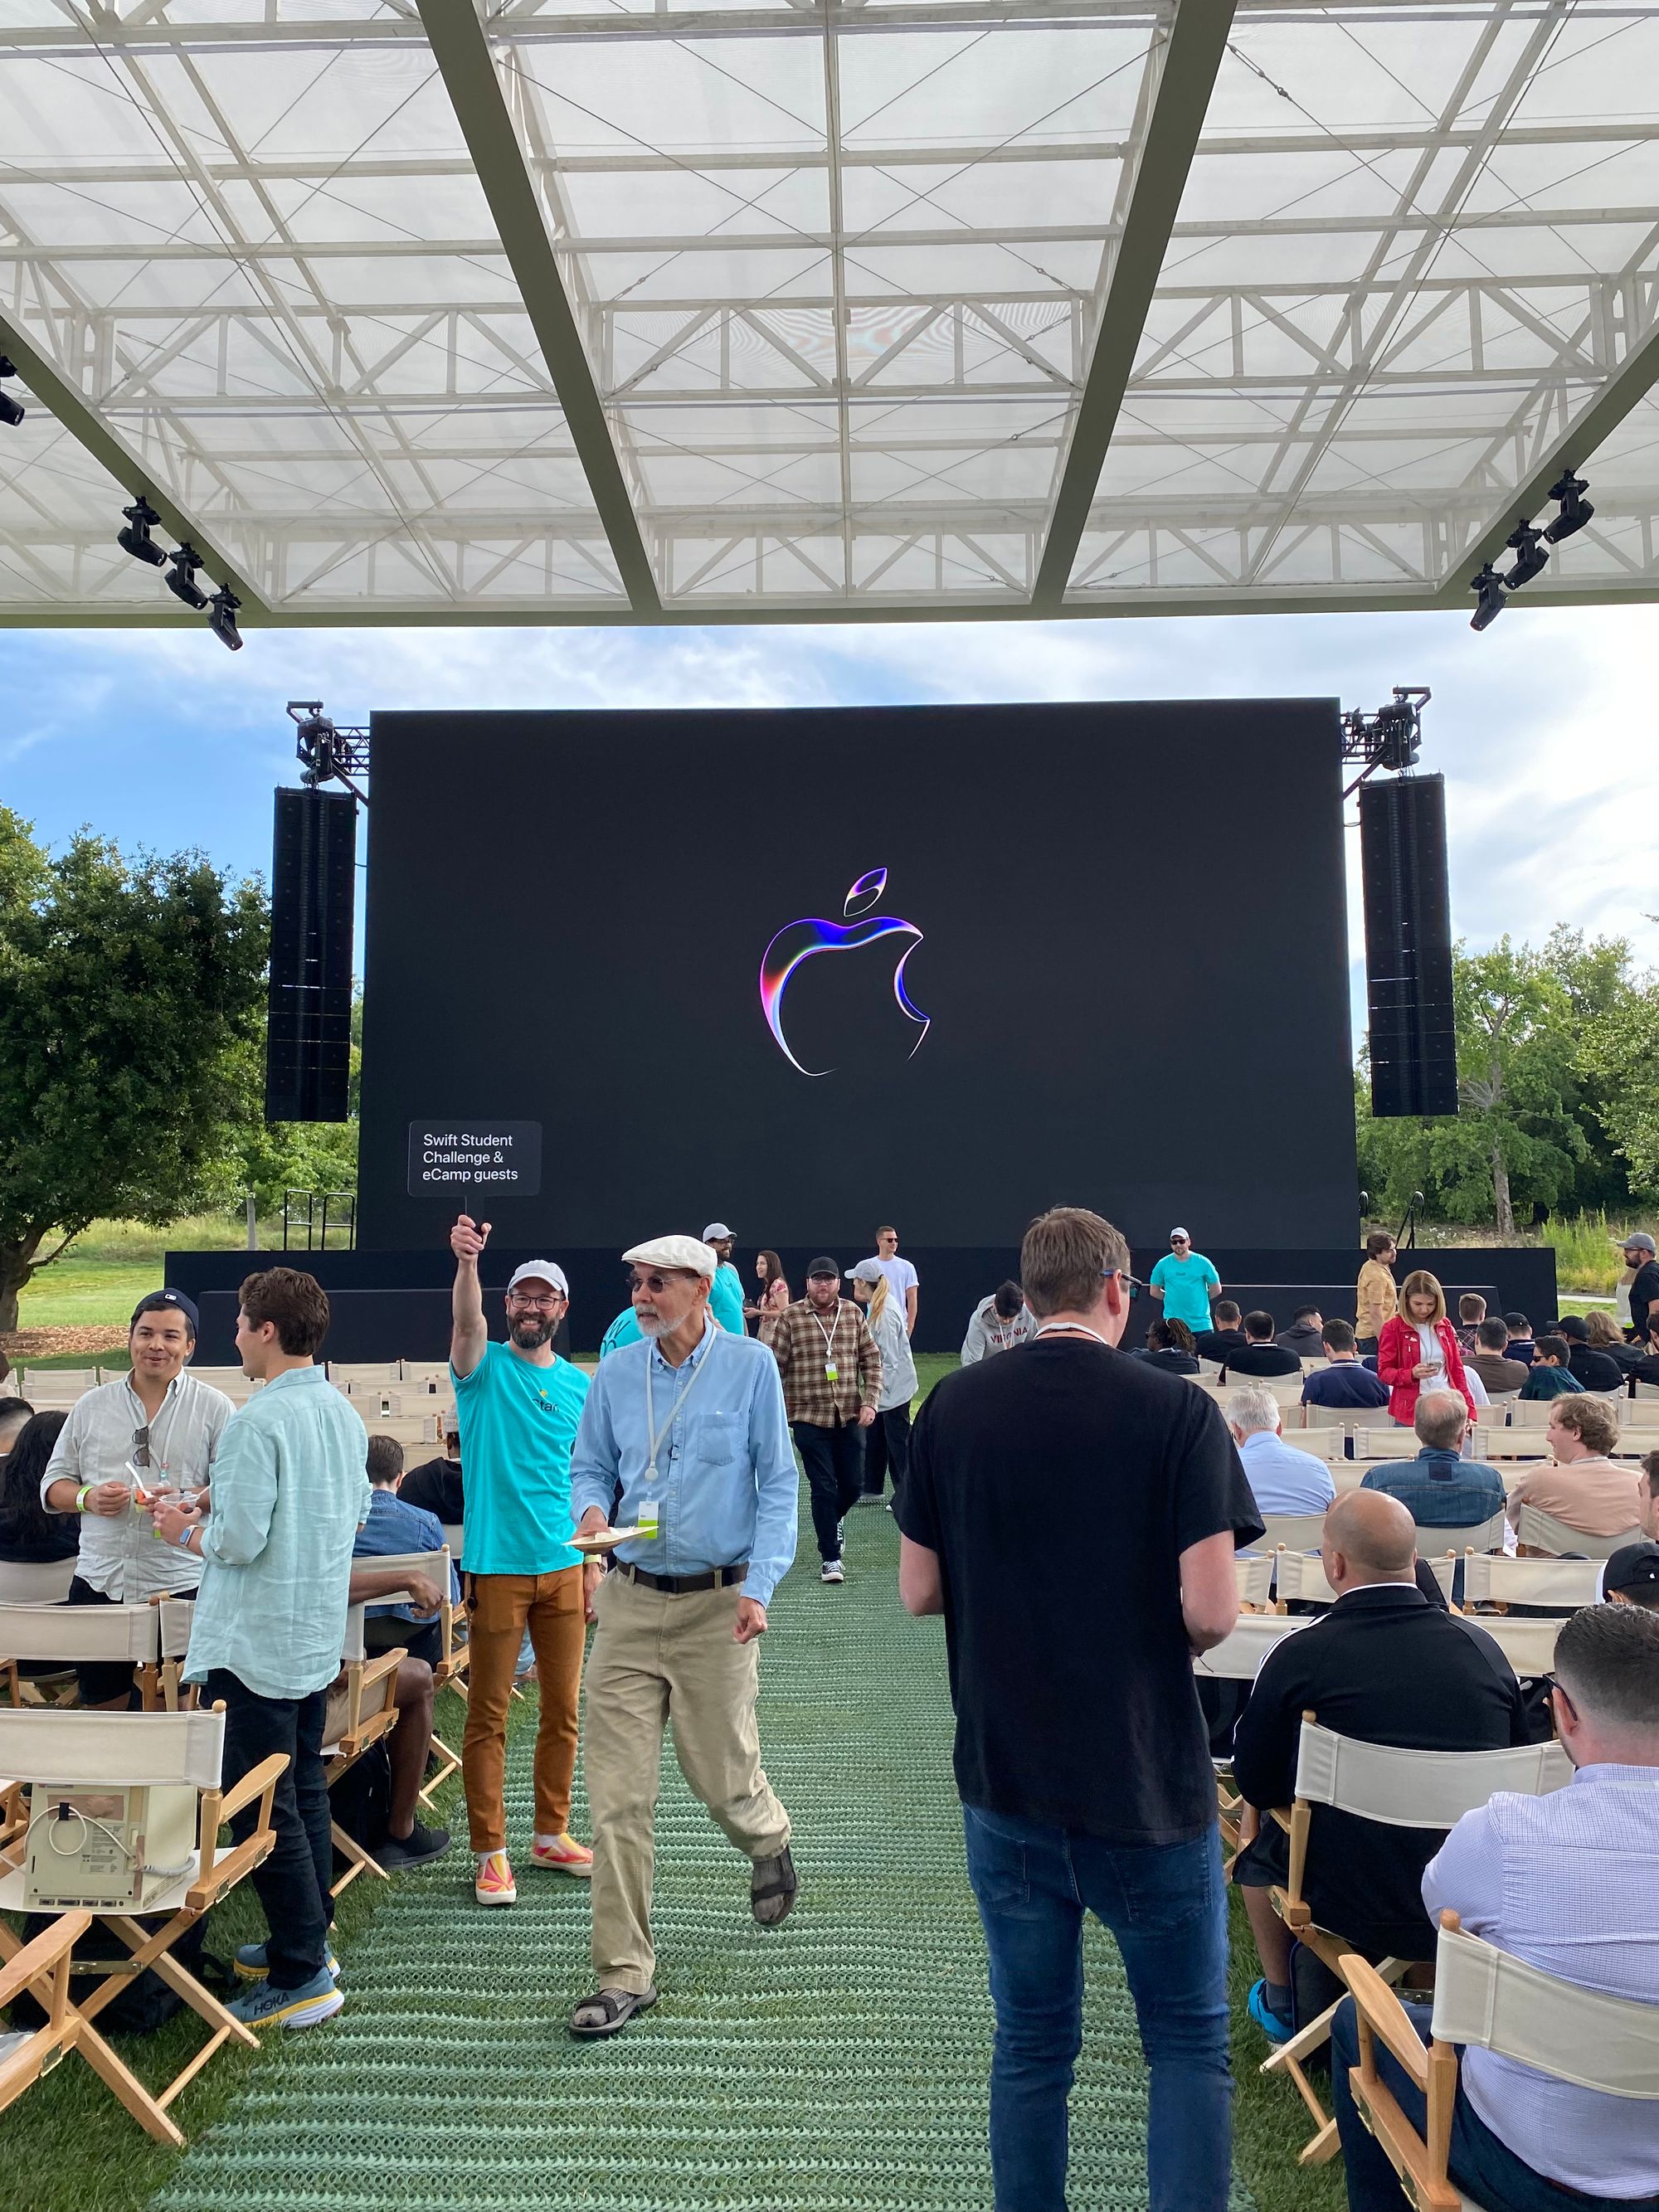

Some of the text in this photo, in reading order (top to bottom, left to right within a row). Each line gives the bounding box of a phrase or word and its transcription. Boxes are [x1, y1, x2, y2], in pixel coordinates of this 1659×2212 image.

[423, 1134, 513, 1146] Swift Student
[423, 1151, 504, 1165] Challenge &
[422, 1168, 518, 1183] eCamp guests
[990, 1327, 1028, 1344] VIRGNIA
[254, 1992, 289, 2015] HOKA
